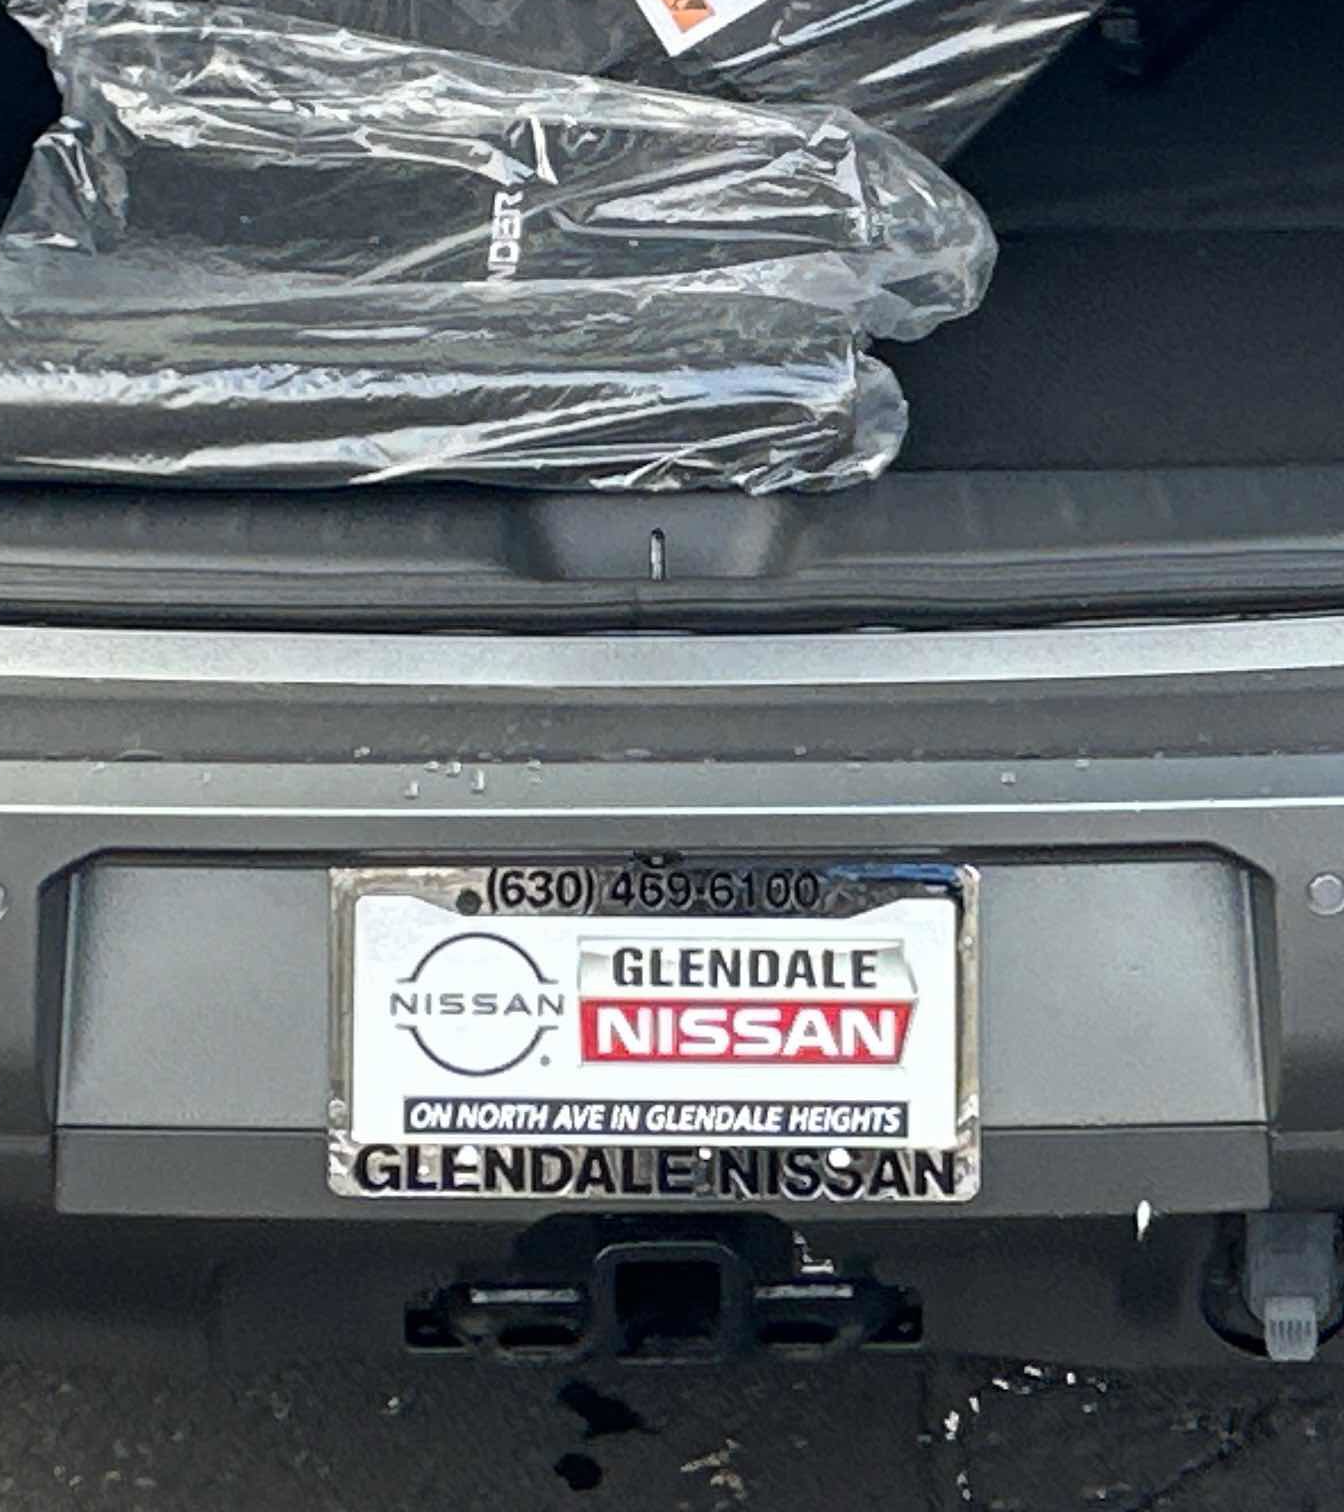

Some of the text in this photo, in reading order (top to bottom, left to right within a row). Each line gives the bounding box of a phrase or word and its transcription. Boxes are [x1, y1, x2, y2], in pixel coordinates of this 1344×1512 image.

[486, 866, 595, 913] (630)
[612, 947, 878, 988] GLENDALE
[389, 992, 565, 1016] NISSAN
[596, 1006, 897, 1056] NISSAN
[410, 1102, 902, 1133] ON NORTH AVE IN GLENDALE HEIGHTS
[356, 1144, 954, 1196] GLENDALE NISSAN
